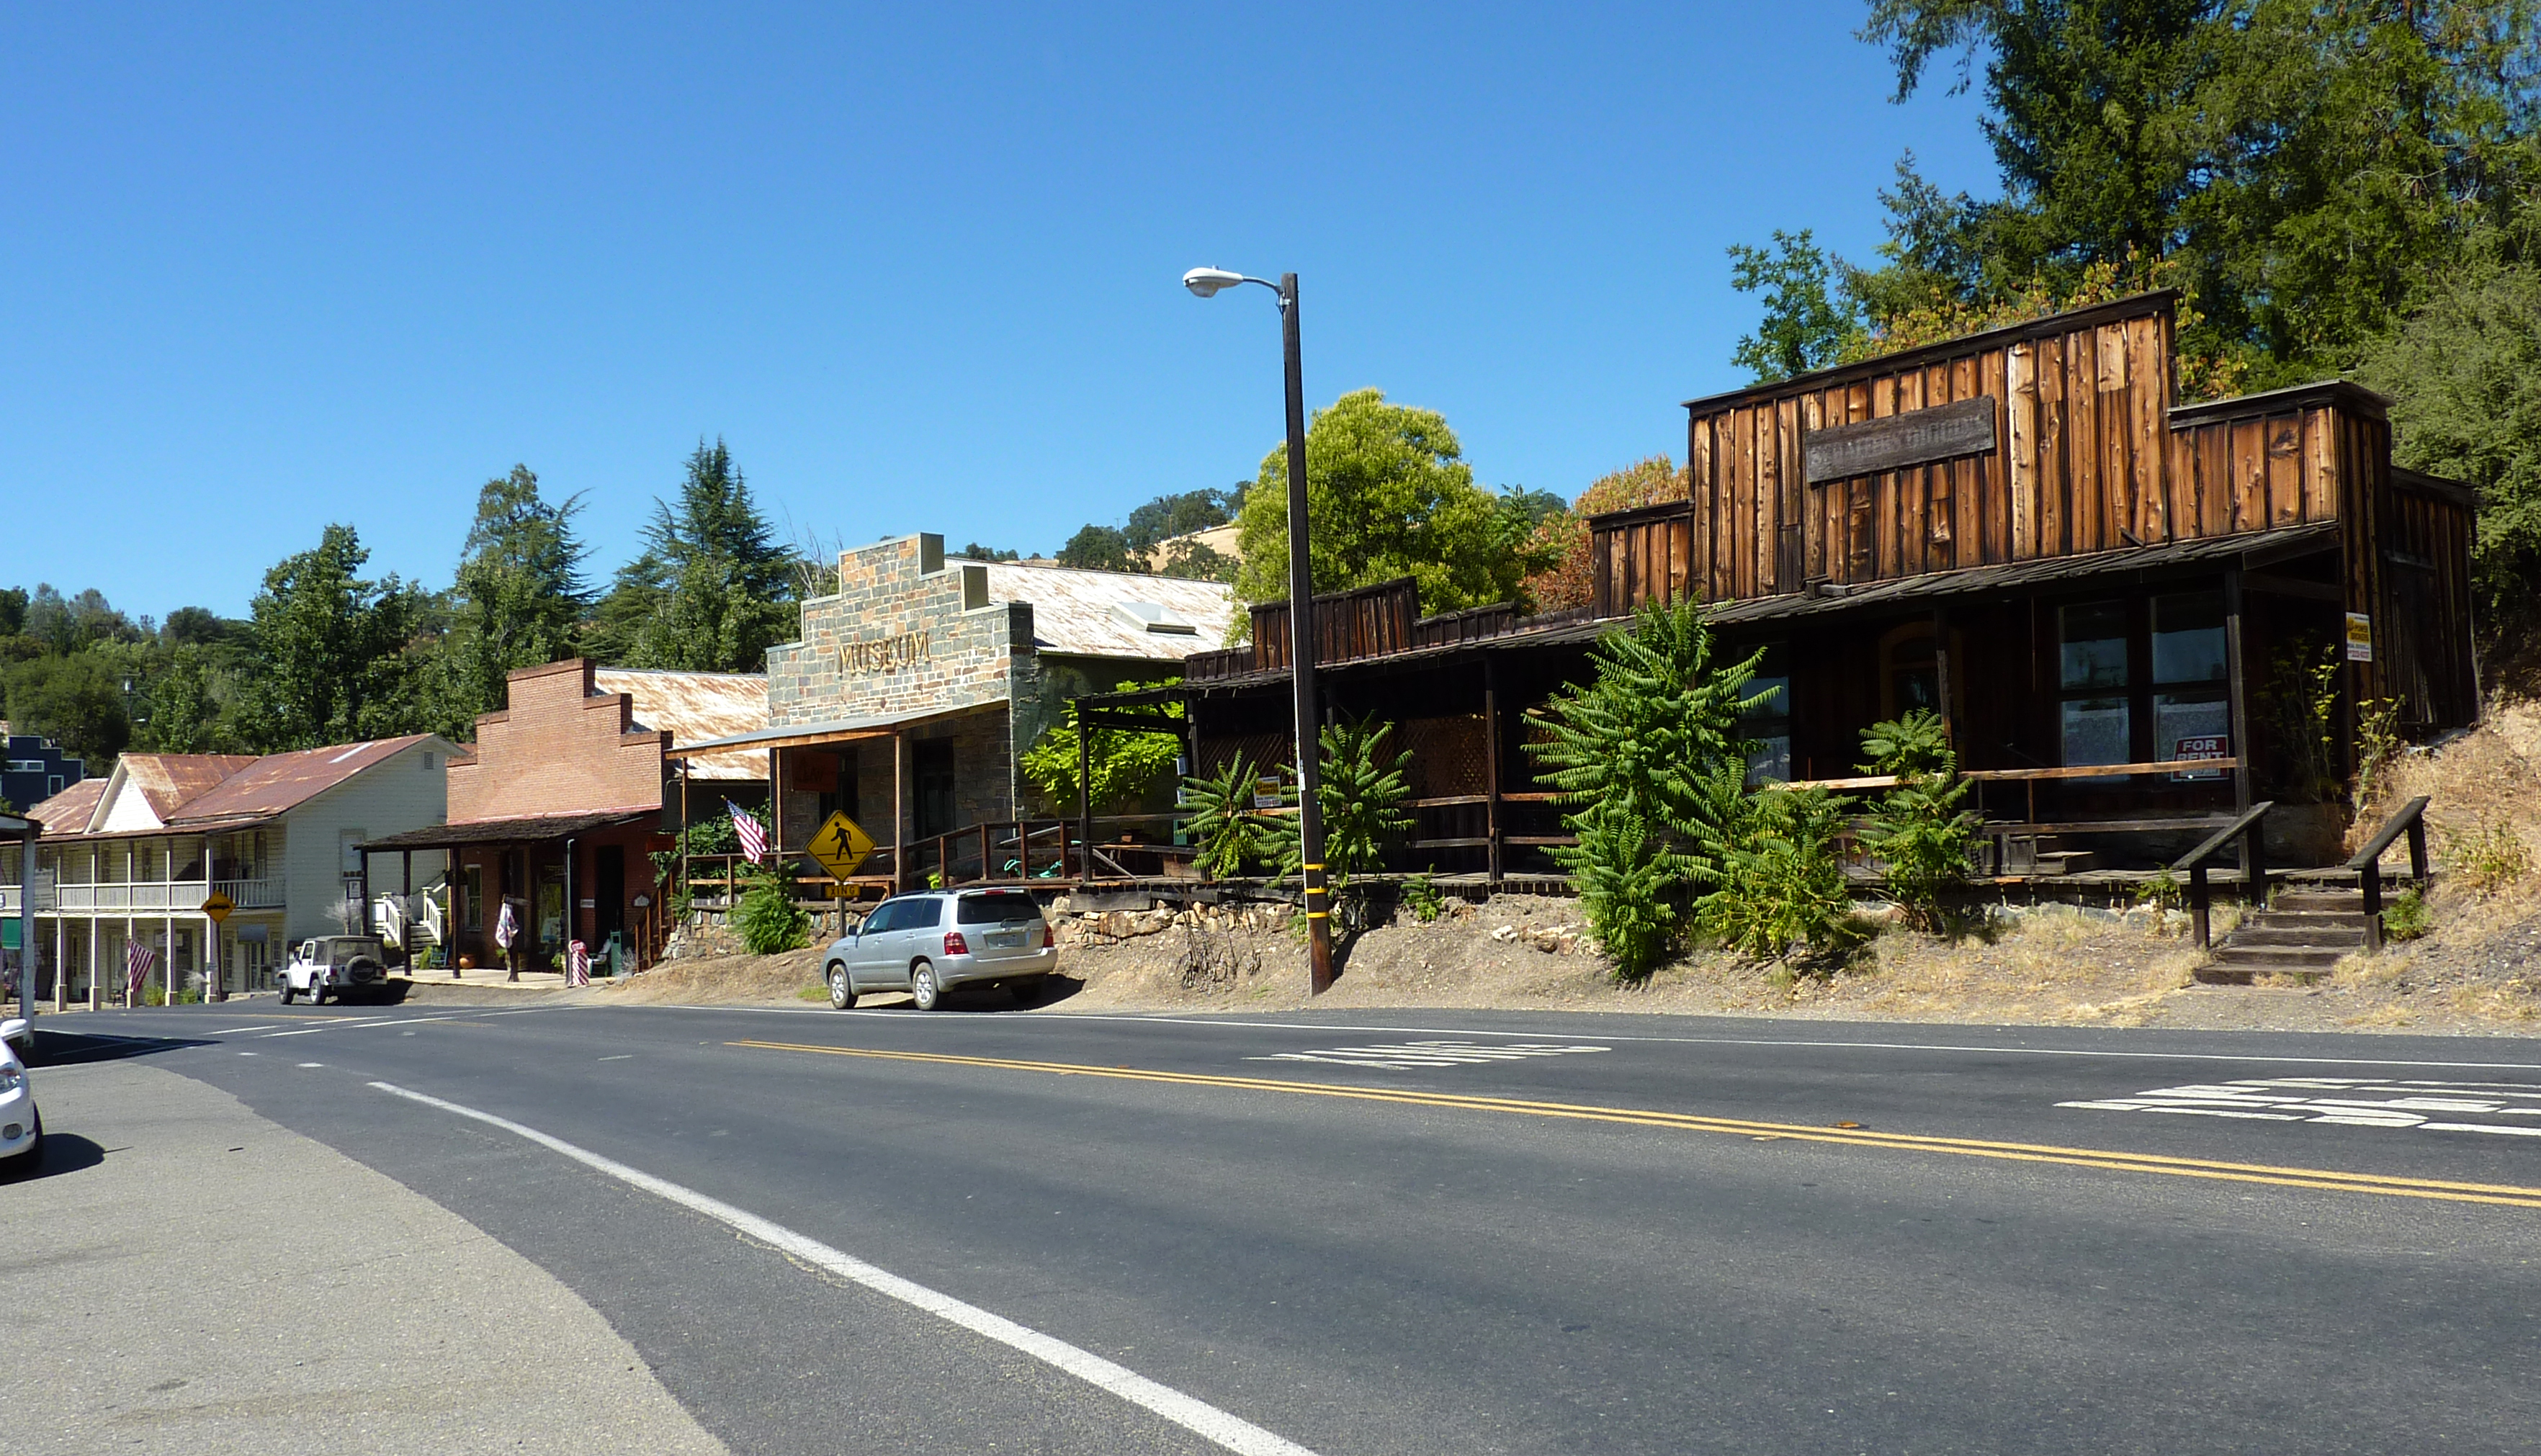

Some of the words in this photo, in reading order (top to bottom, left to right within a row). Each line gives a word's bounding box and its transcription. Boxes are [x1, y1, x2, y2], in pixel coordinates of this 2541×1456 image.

[838, 631, 931, 679] MUSEUM
[2182, 740, 2218, 752] FOR
[831, 886, 855, 896] XING
